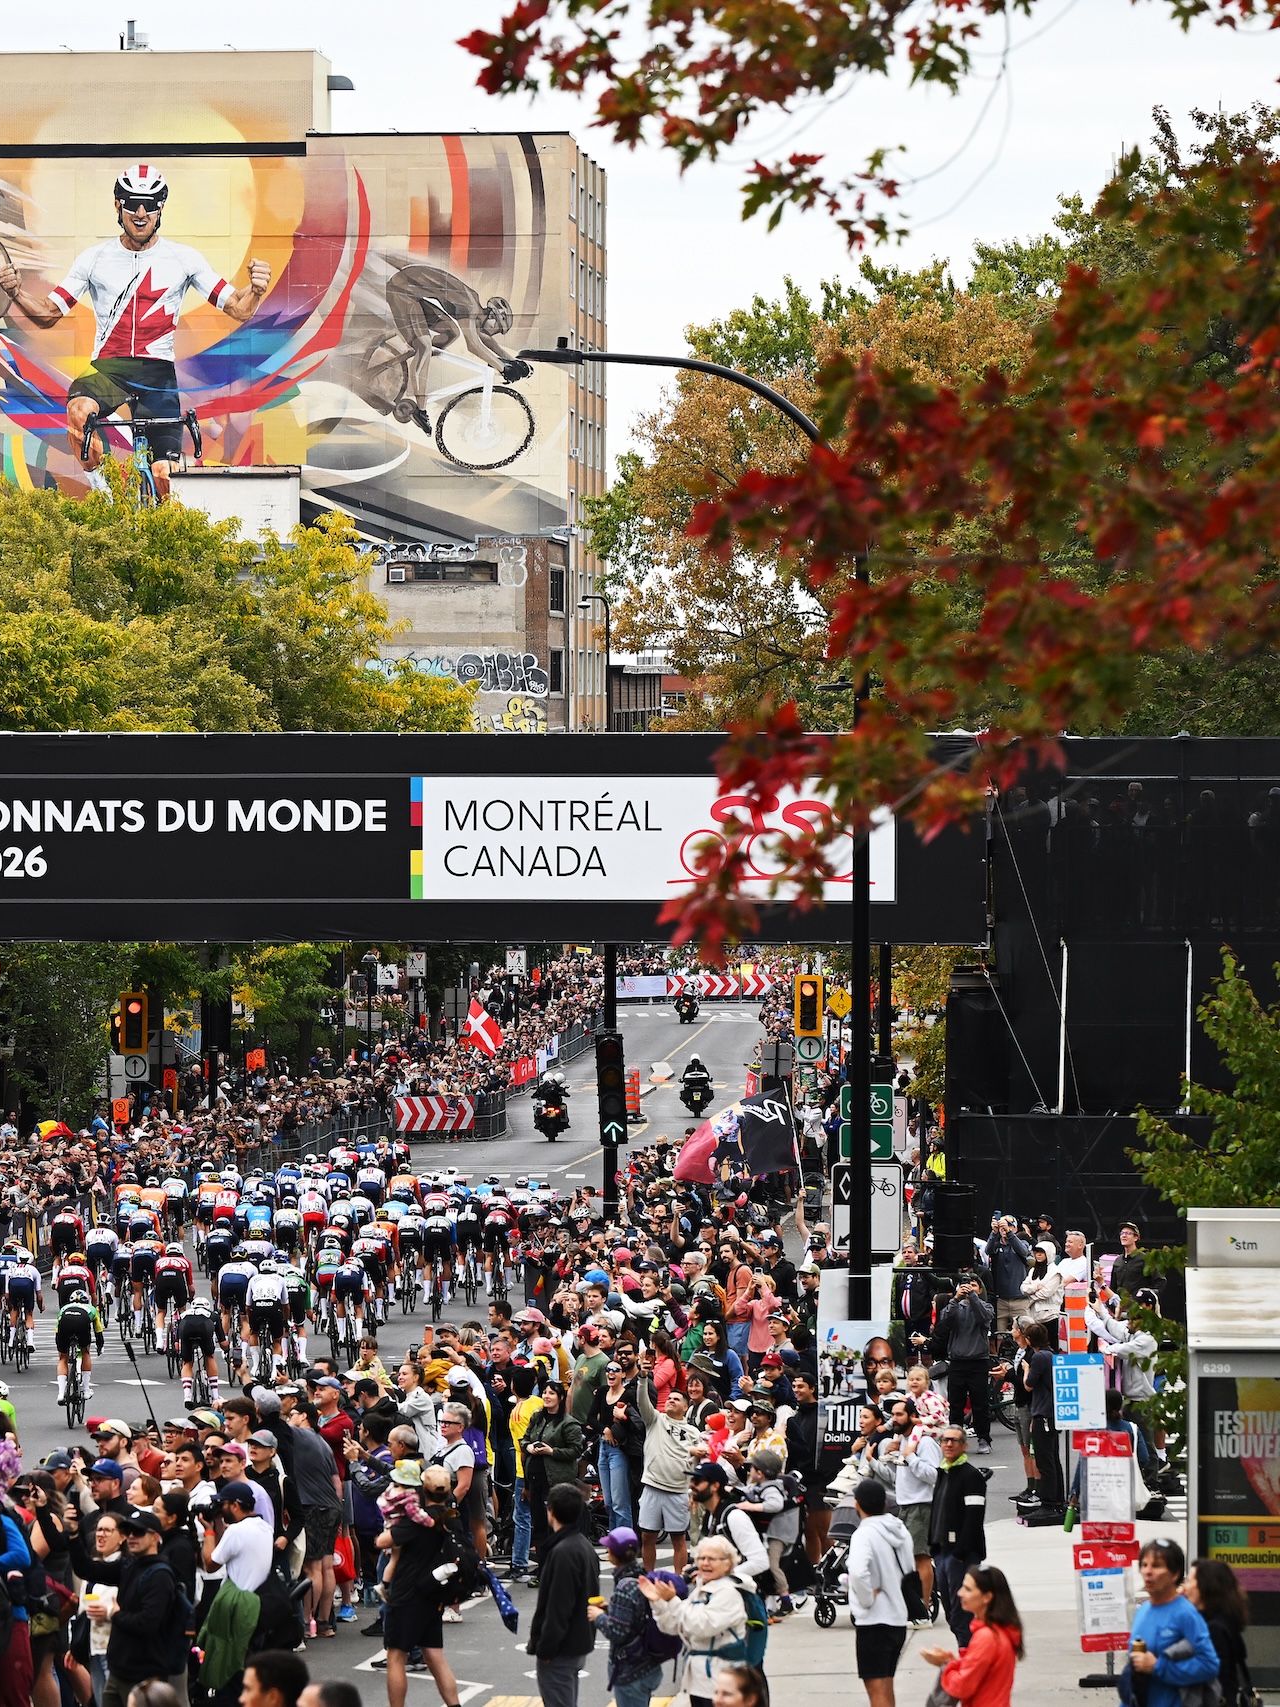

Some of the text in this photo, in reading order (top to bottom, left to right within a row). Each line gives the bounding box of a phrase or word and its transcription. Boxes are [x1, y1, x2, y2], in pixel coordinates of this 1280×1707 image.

[157, 800, 213, 833] DU
[227, 799, 387, 833] MONDE
[444, 792, 662, 832] MONTRÉAL
[444, 845, 607, 878] CANADA
[1235, 1240, 1257, 1250] stm
[1203, 1363, 1231, 1374] 6290
[1057, 1370, 1069, 1380] 11
[1058, 1388, 1076, 1398] 711
[1058, 1406, 1078, 1416] 804
[825, 1405, 861, 1432] THIE
[824, 1433, 851, 1443] Diallo
[1215, 1530, 1231, 1544] 55
[1258, 1530, 1266, 1543] 8
